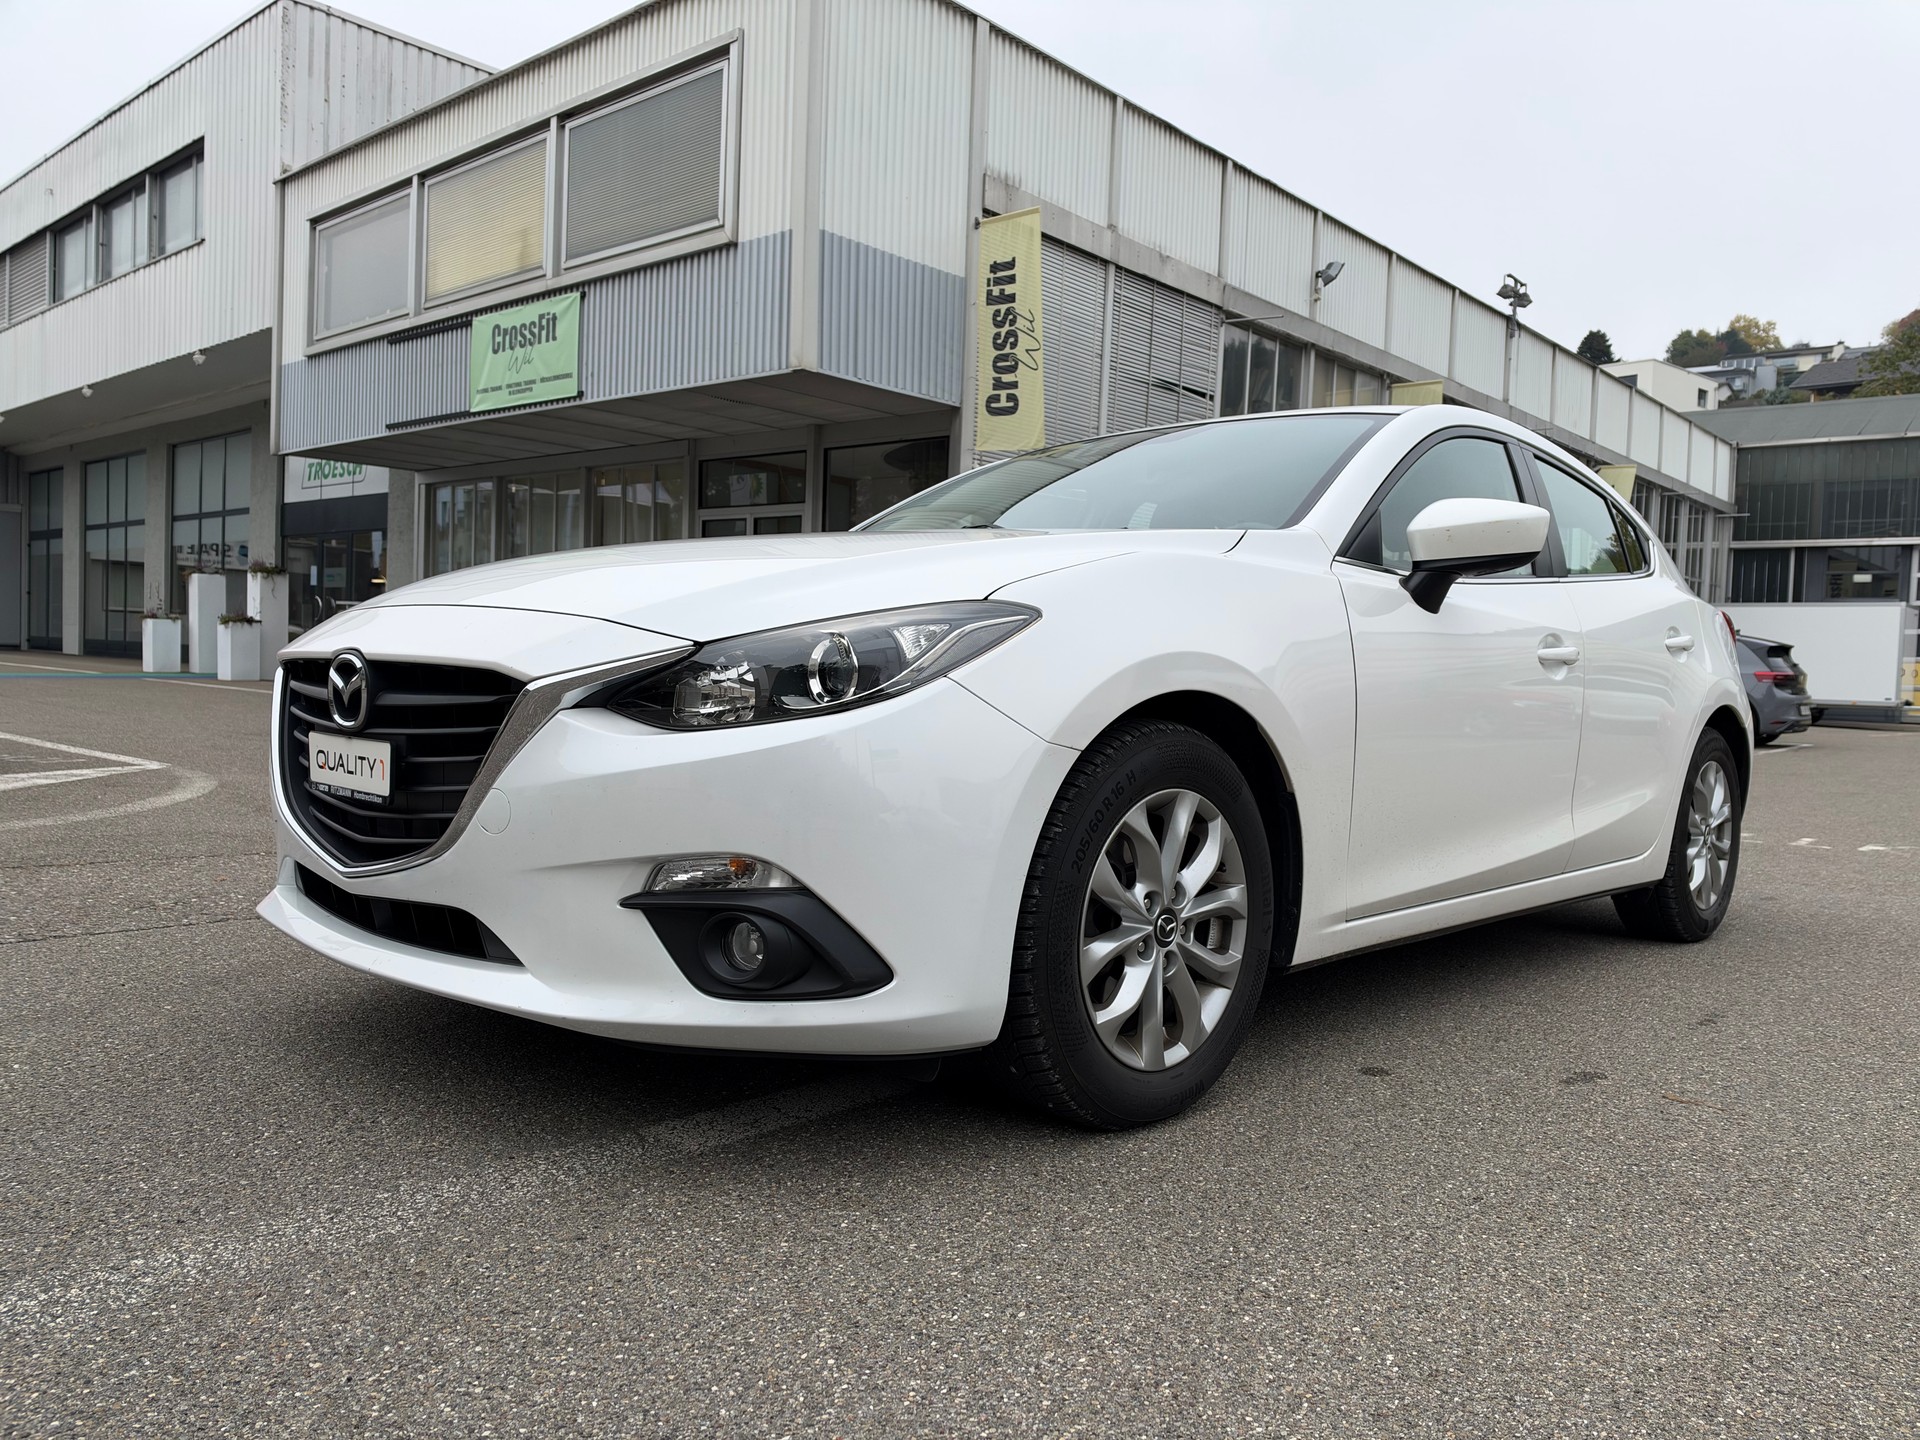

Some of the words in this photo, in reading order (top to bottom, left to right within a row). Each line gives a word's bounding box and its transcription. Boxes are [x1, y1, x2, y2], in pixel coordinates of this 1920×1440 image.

[492, 312, 557, 354] CrossFit
[985, 257, 1019, 417] CrossFit
[308, 460, 363, 481] TROESCH
[1071, 808, 1106, 874] 205/60
[1101, 796, 1114, 812] R
[1110, 781, 1125, 800] 16
[1125, 769, 1137, 786] H
